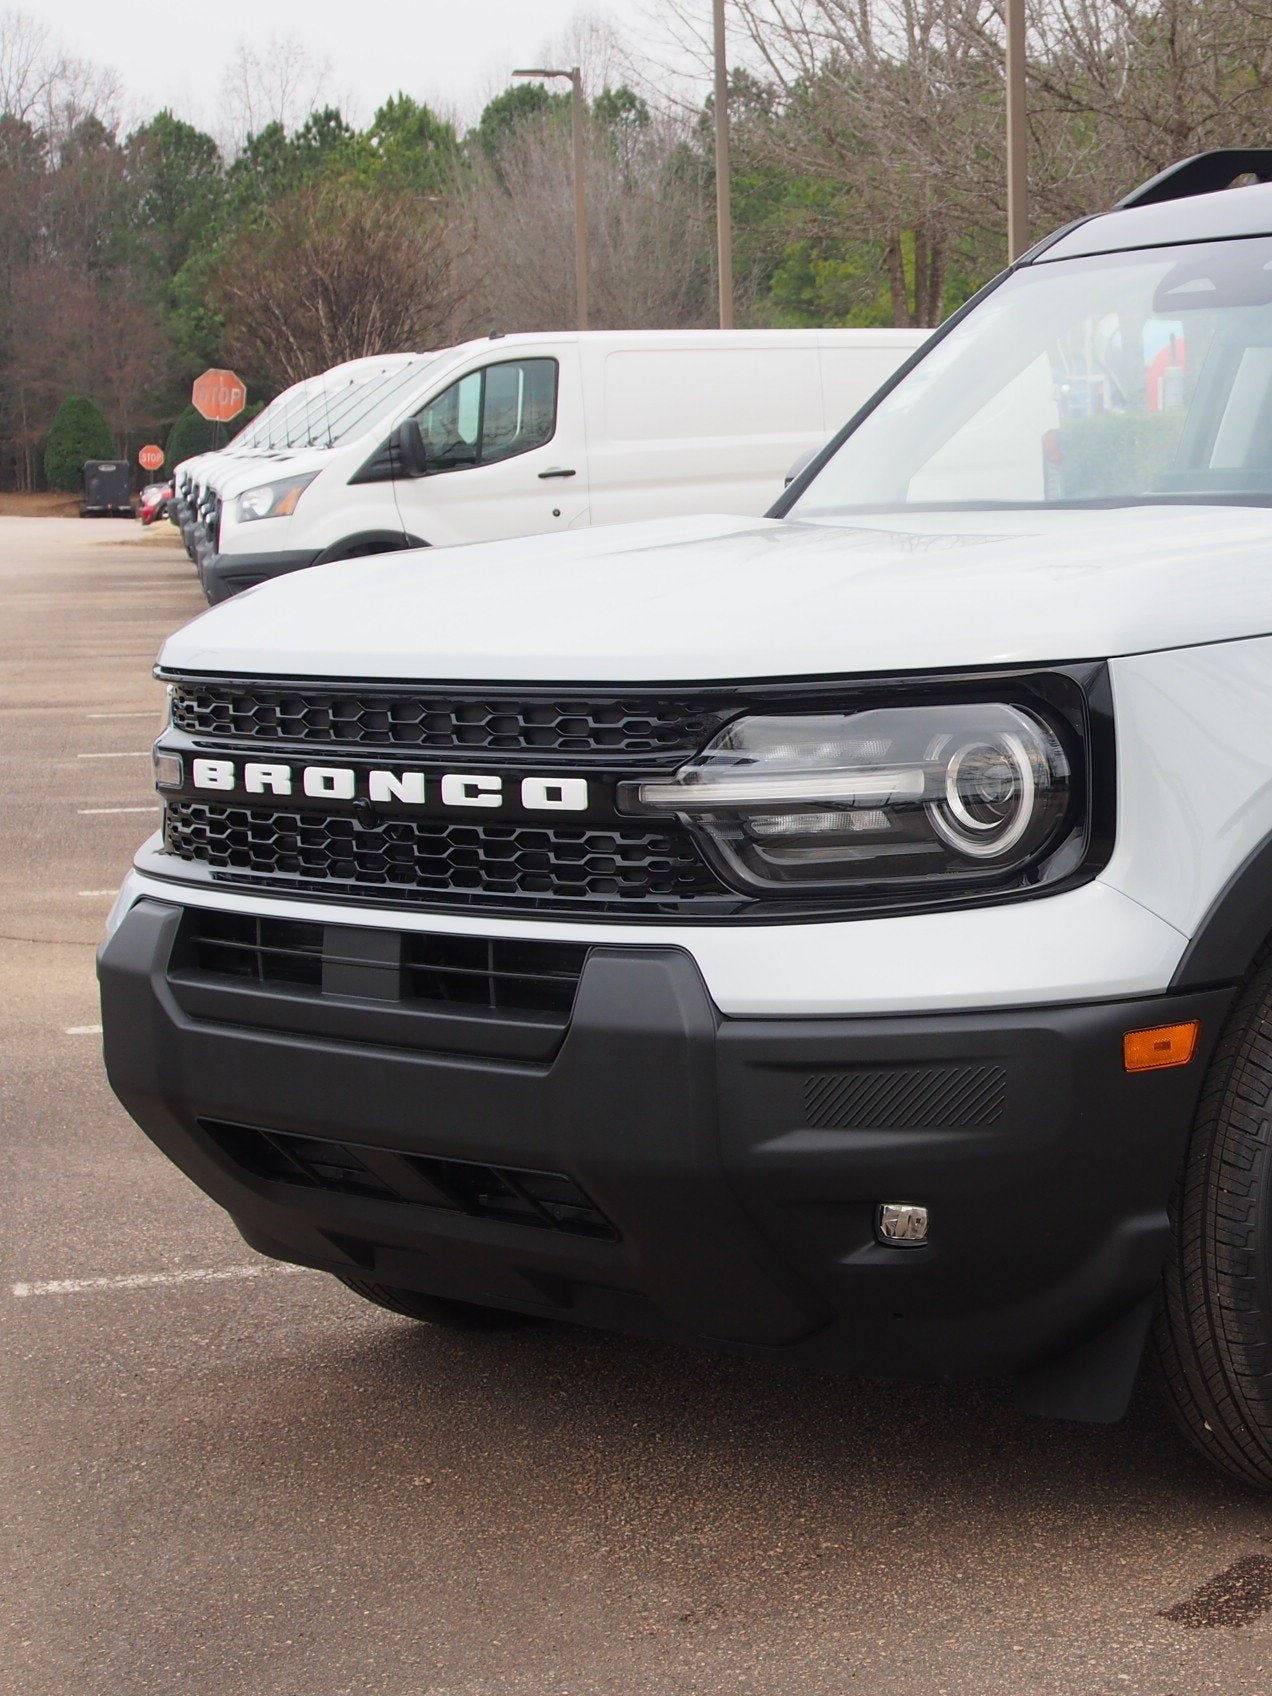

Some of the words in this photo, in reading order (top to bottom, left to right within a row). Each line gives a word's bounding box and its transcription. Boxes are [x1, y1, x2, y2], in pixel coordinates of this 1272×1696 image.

[198, 384, 242, 406] STOP
[141, 452, 162, 463] STOP
[193, 758, 548, 811] BRONCO
